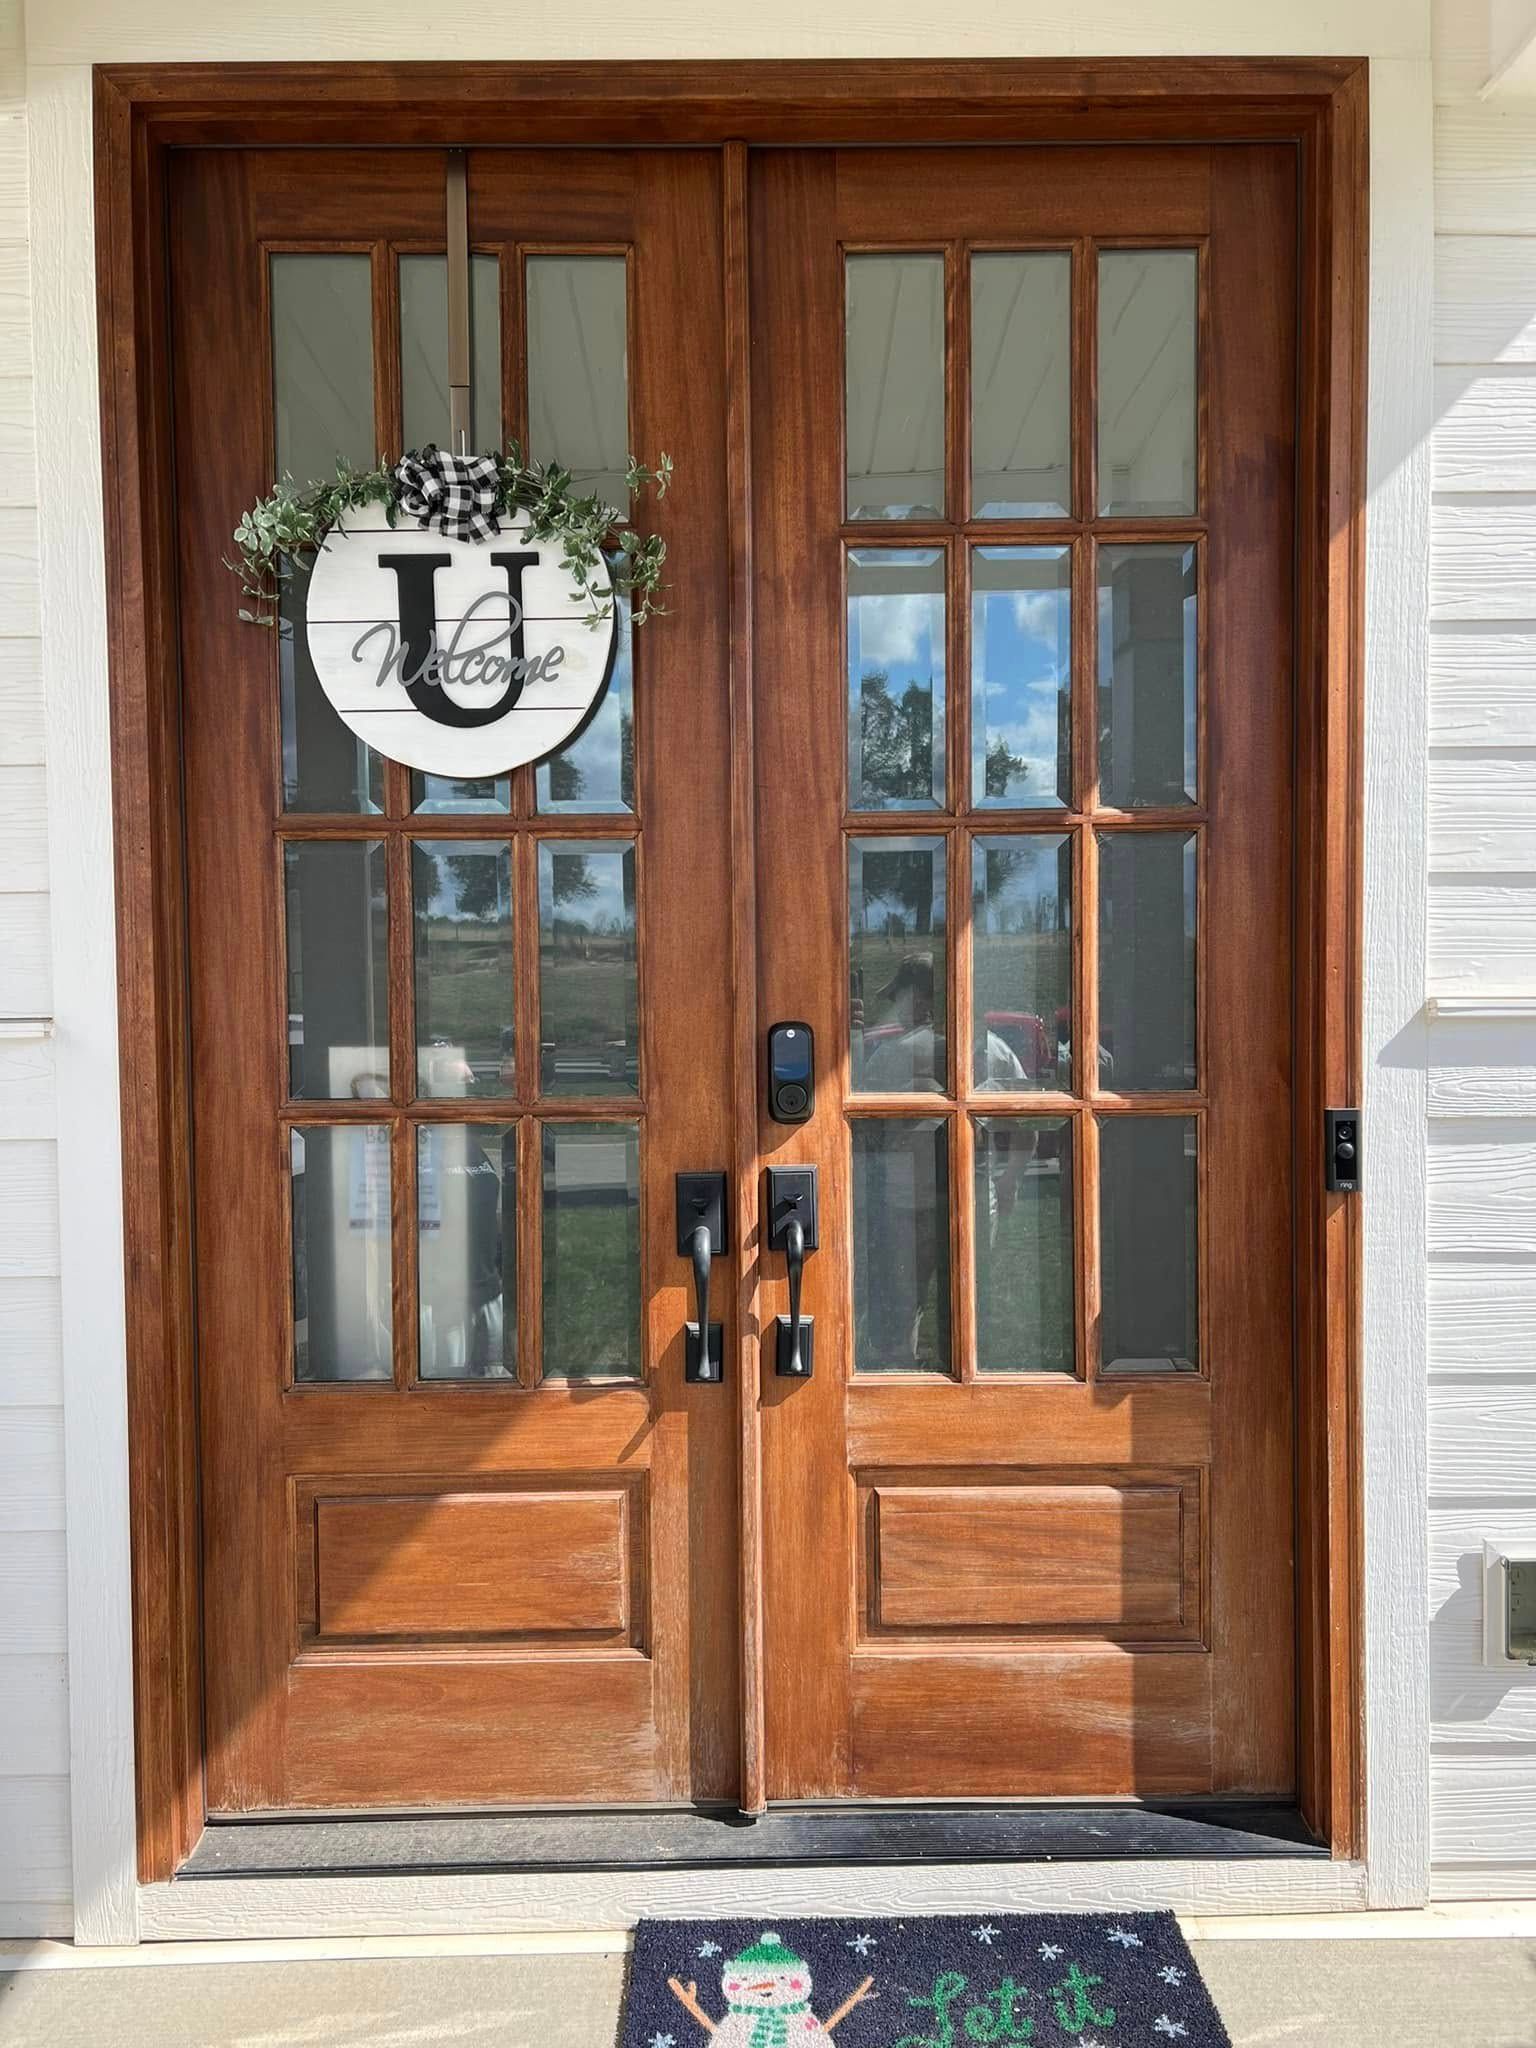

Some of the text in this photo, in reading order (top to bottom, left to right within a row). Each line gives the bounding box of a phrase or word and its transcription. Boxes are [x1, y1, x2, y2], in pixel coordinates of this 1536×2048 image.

[351, 590, 566, 688] Welcome
[377, 551, 540, 729] U
[897, 1961, 1117, 2048] Let it
